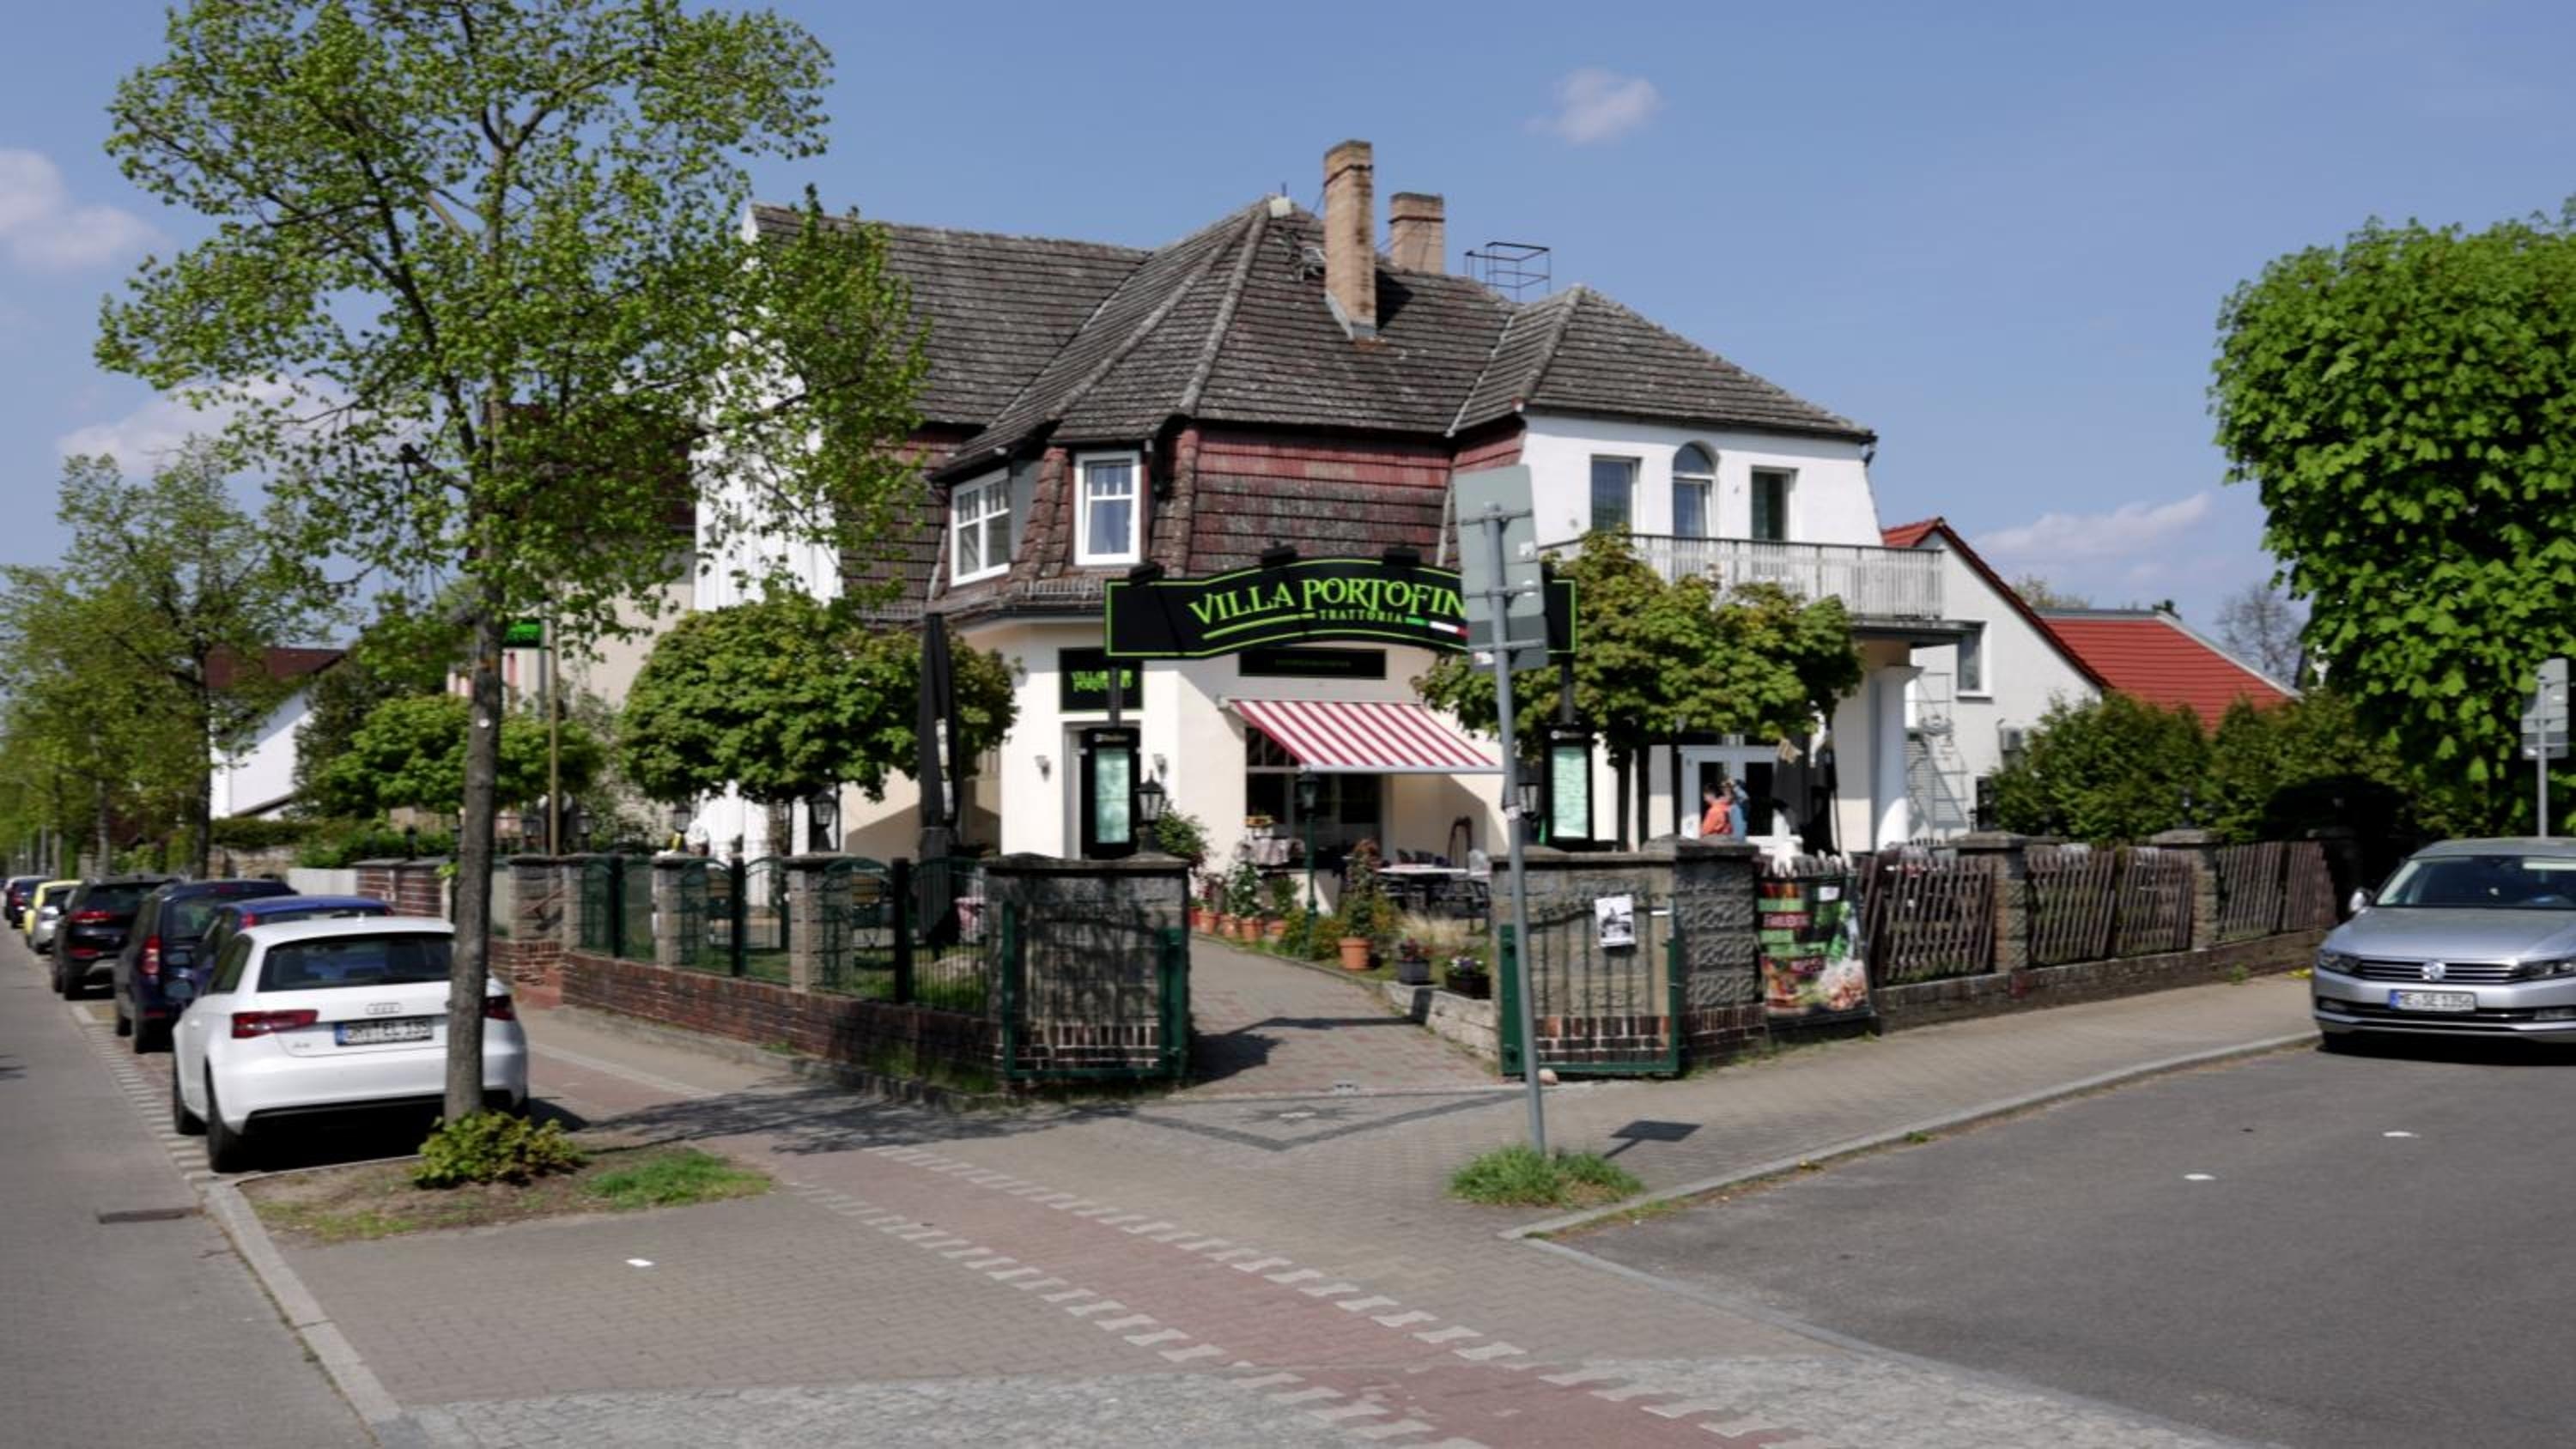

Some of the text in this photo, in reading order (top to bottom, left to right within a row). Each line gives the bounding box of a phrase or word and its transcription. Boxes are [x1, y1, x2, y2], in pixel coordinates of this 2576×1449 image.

[1188, 577, 1467, 625] VILLA PORTOFIN
[1319, 608, 1403, 623] TRATTORIA
